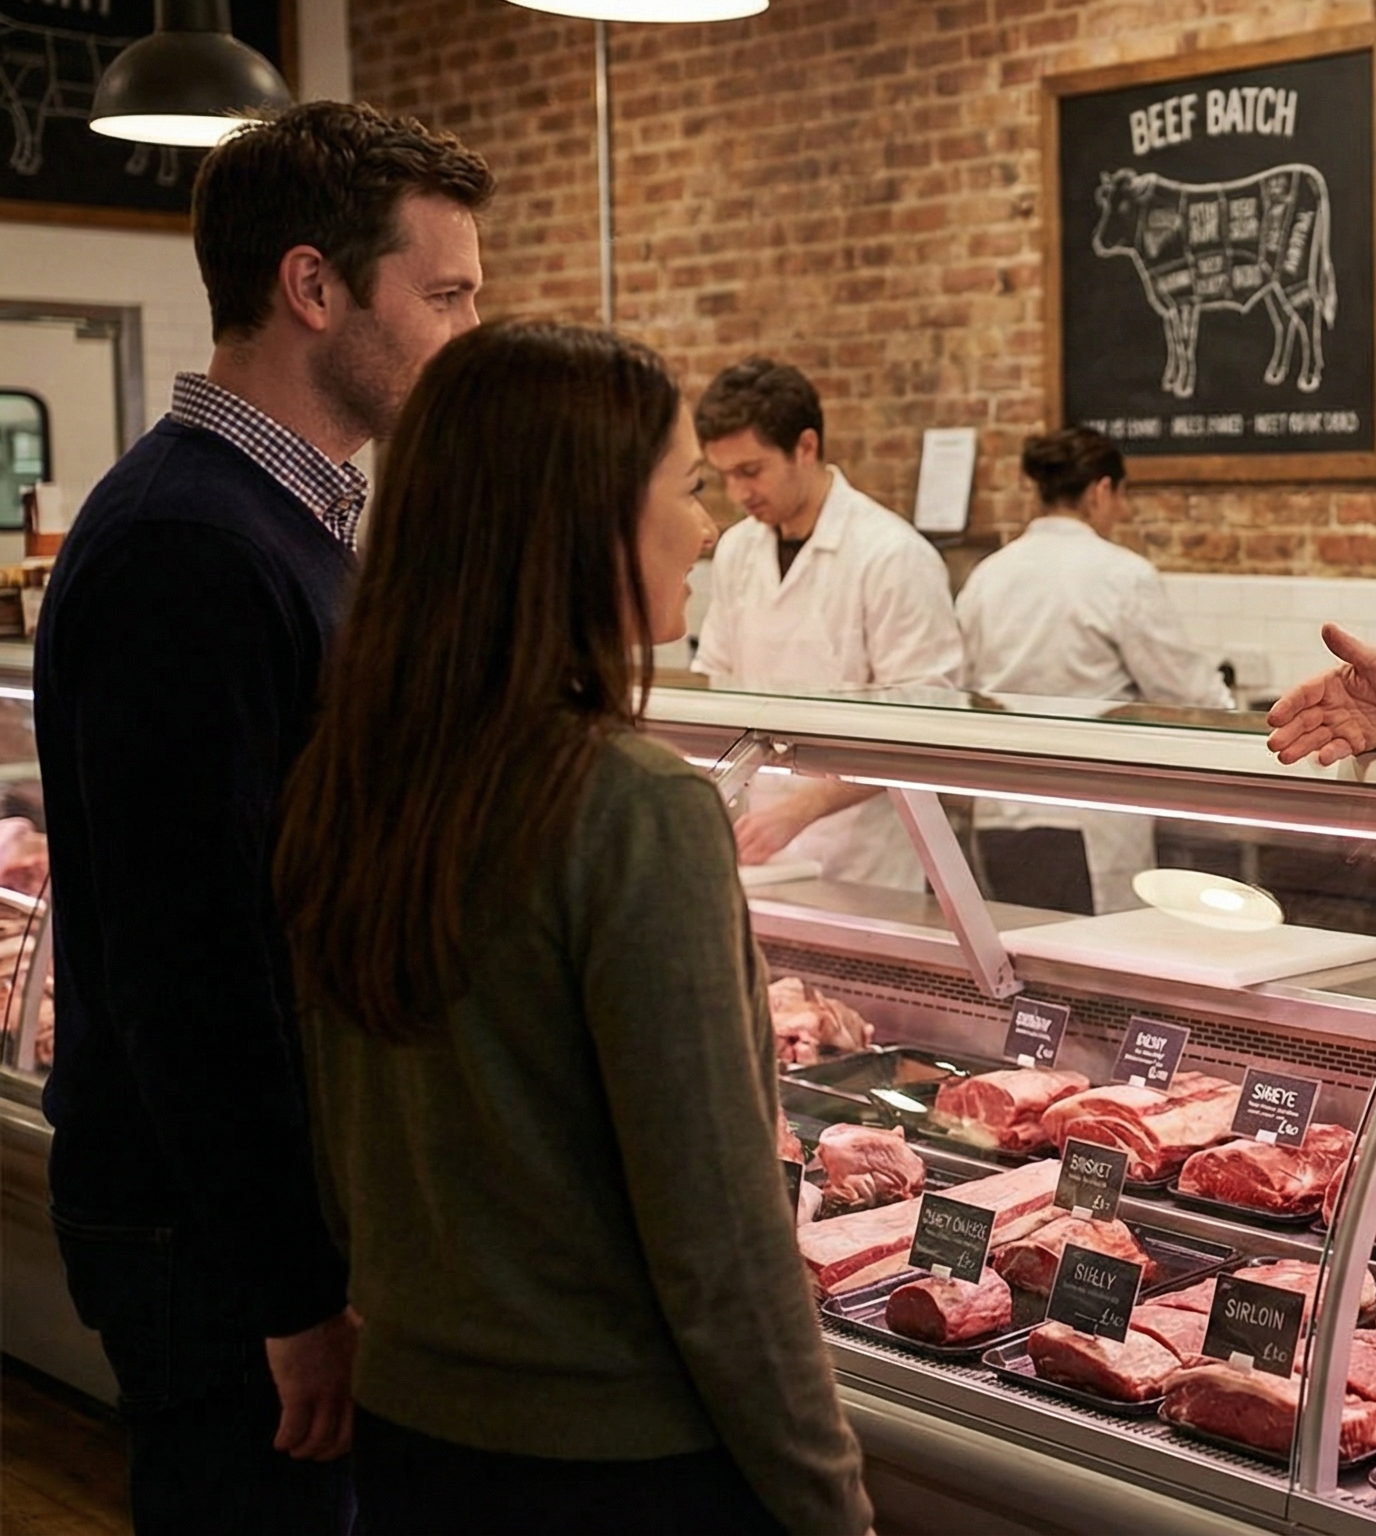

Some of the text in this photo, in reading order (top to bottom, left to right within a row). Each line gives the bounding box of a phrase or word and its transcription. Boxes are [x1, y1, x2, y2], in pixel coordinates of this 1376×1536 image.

[1129, 86, 1298, 156] BEEF BATCH
[1225, 1298, 1285, 1331] SIRLOIN
